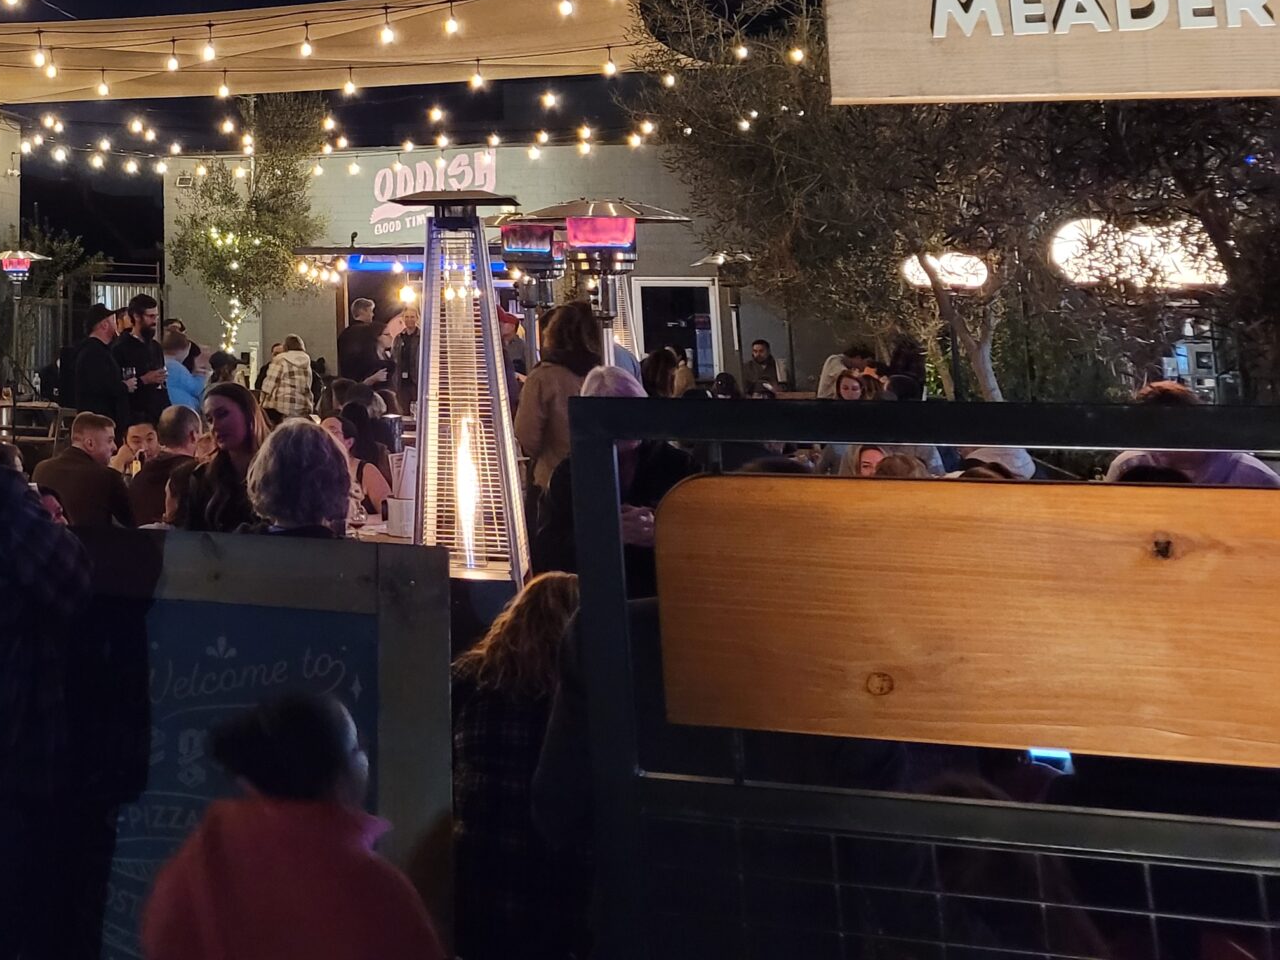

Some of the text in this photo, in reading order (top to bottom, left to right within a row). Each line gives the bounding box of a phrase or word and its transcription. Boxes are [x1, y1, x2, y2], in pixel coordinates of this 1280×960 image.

[374, 149, 496, 202] ODDISH
[374, 211, 433, 235] GOOD TIM
[303, 644, 346, 695] to
